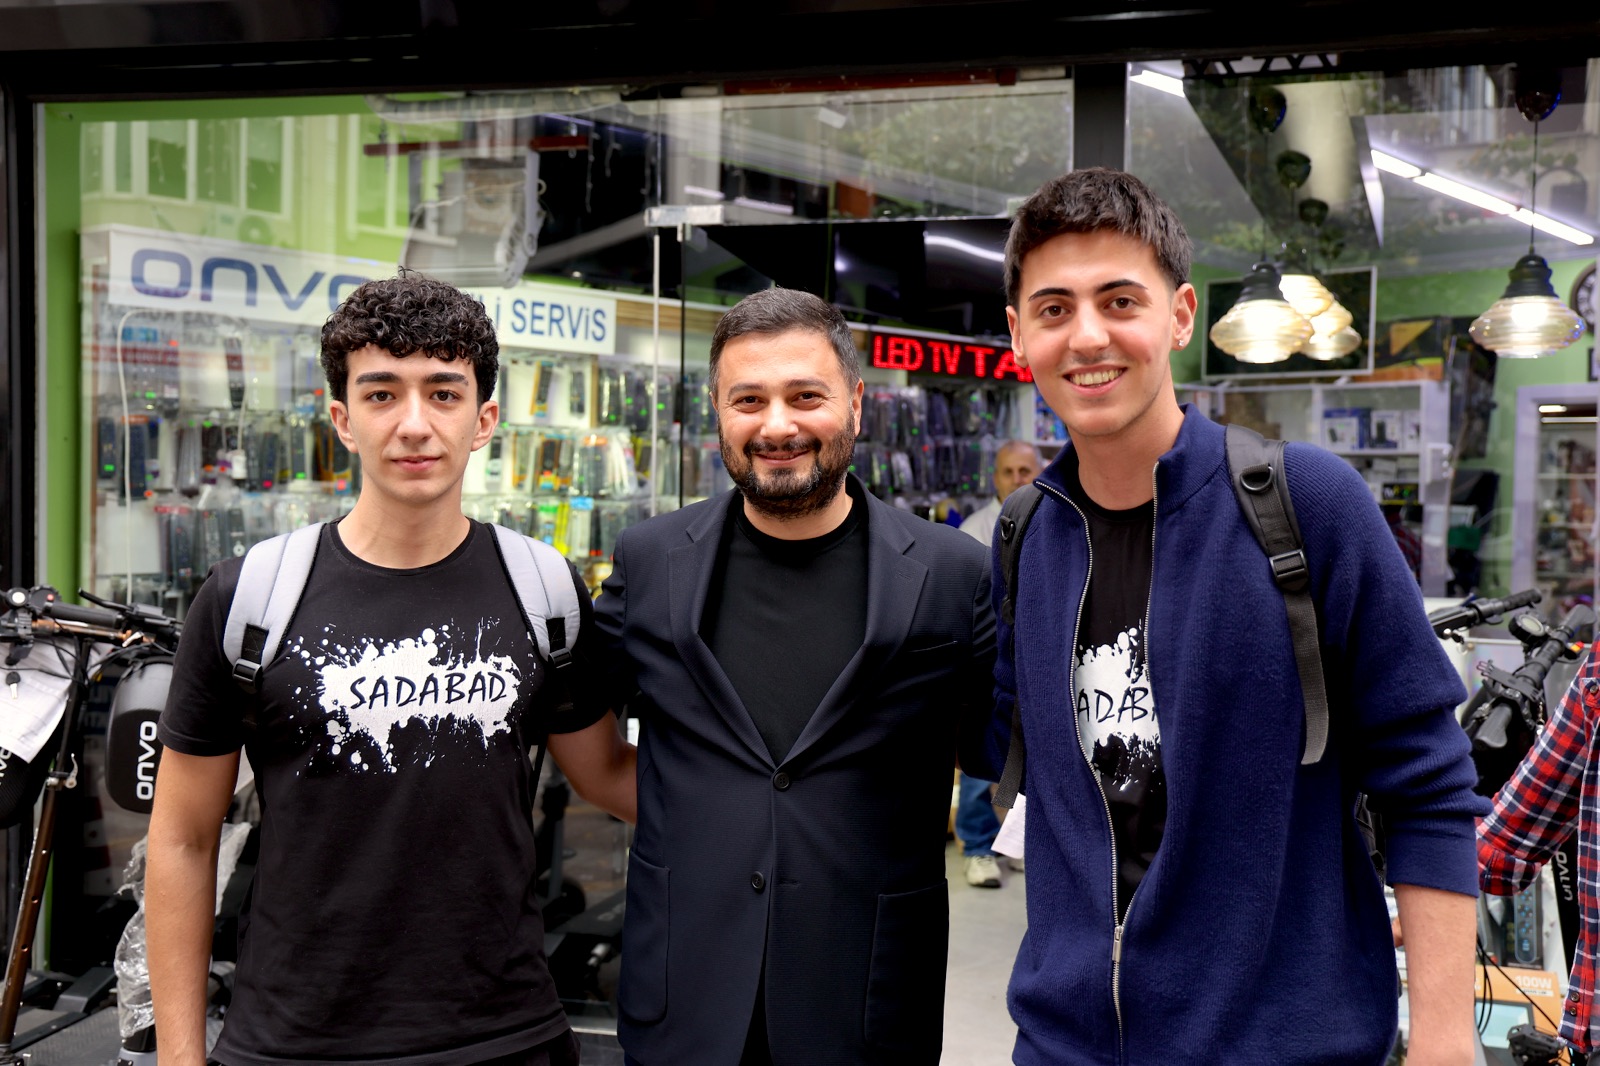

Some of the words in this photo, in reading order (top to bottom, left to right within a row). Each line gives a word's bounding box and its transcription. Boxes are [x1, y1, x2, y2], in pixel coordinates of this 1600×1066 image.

[873, 335, 925, 371] LED
[927, 341, 961, 375] TV
[965, 346, 1034, 383] TA
[350, 671, 507, 709] SADABAD
[1077, 686, 1156, 723] ADAB
[136, 721, 157, 800] onvo
